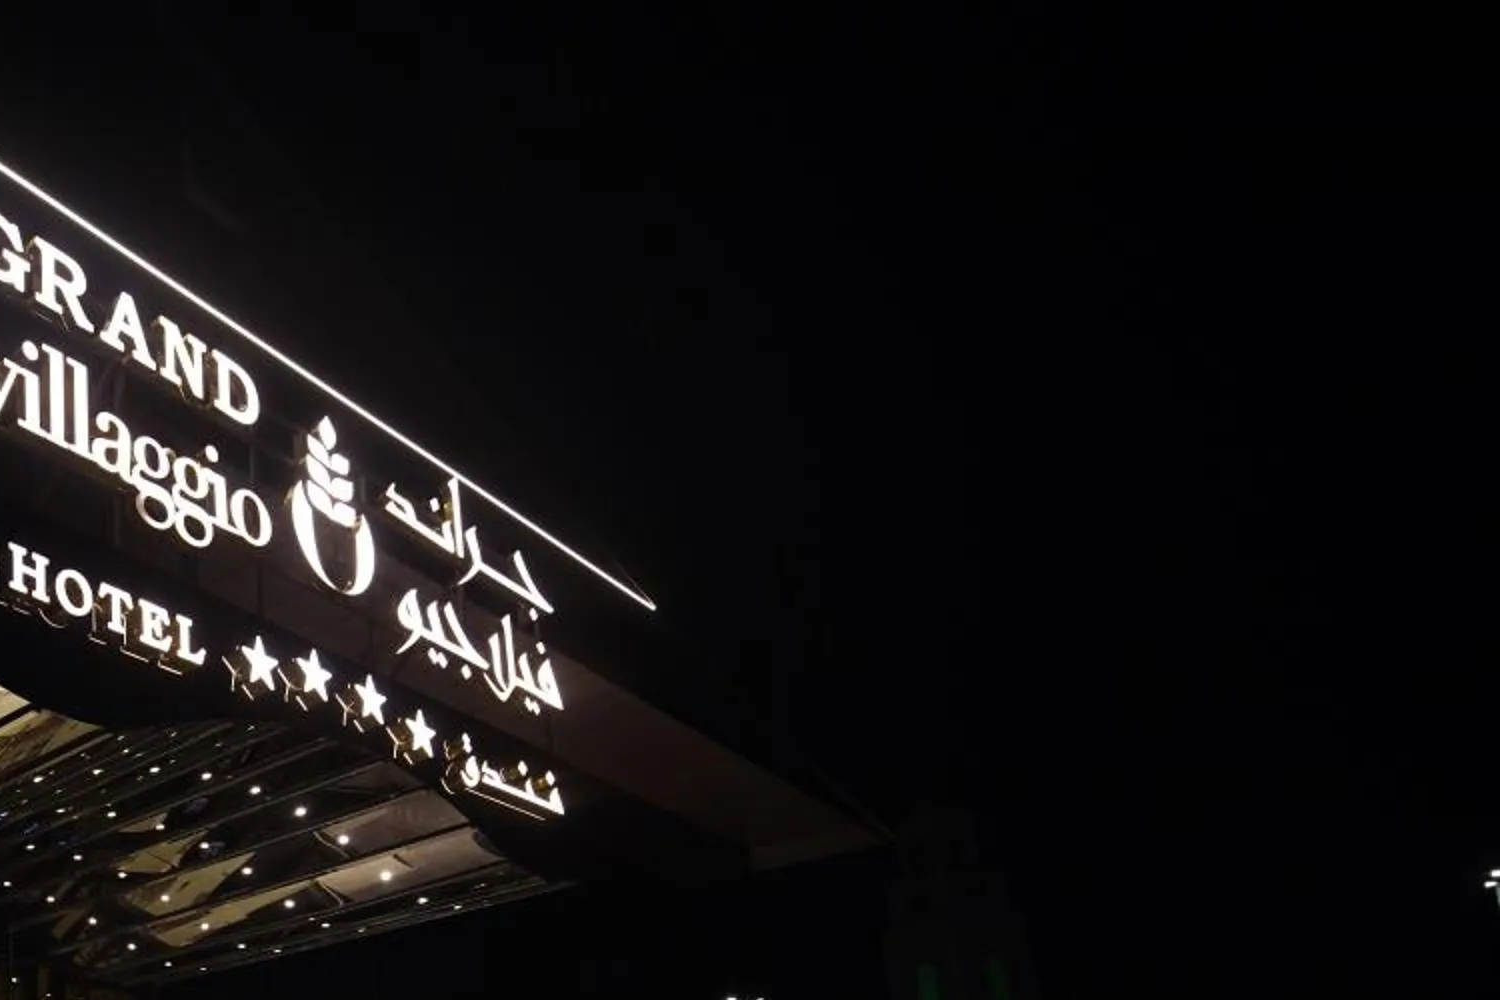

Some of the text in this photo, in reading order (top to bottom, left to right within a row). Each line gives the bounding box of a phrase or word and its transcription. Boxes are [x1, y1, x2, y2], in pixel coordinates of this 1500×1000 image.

[7, 540, 208, 667] HOTEL
[384, 476, 555, 621] جراند
[396, 587, 565, 716] فيلاجيو
[460, 731, 566, 816] فندق
